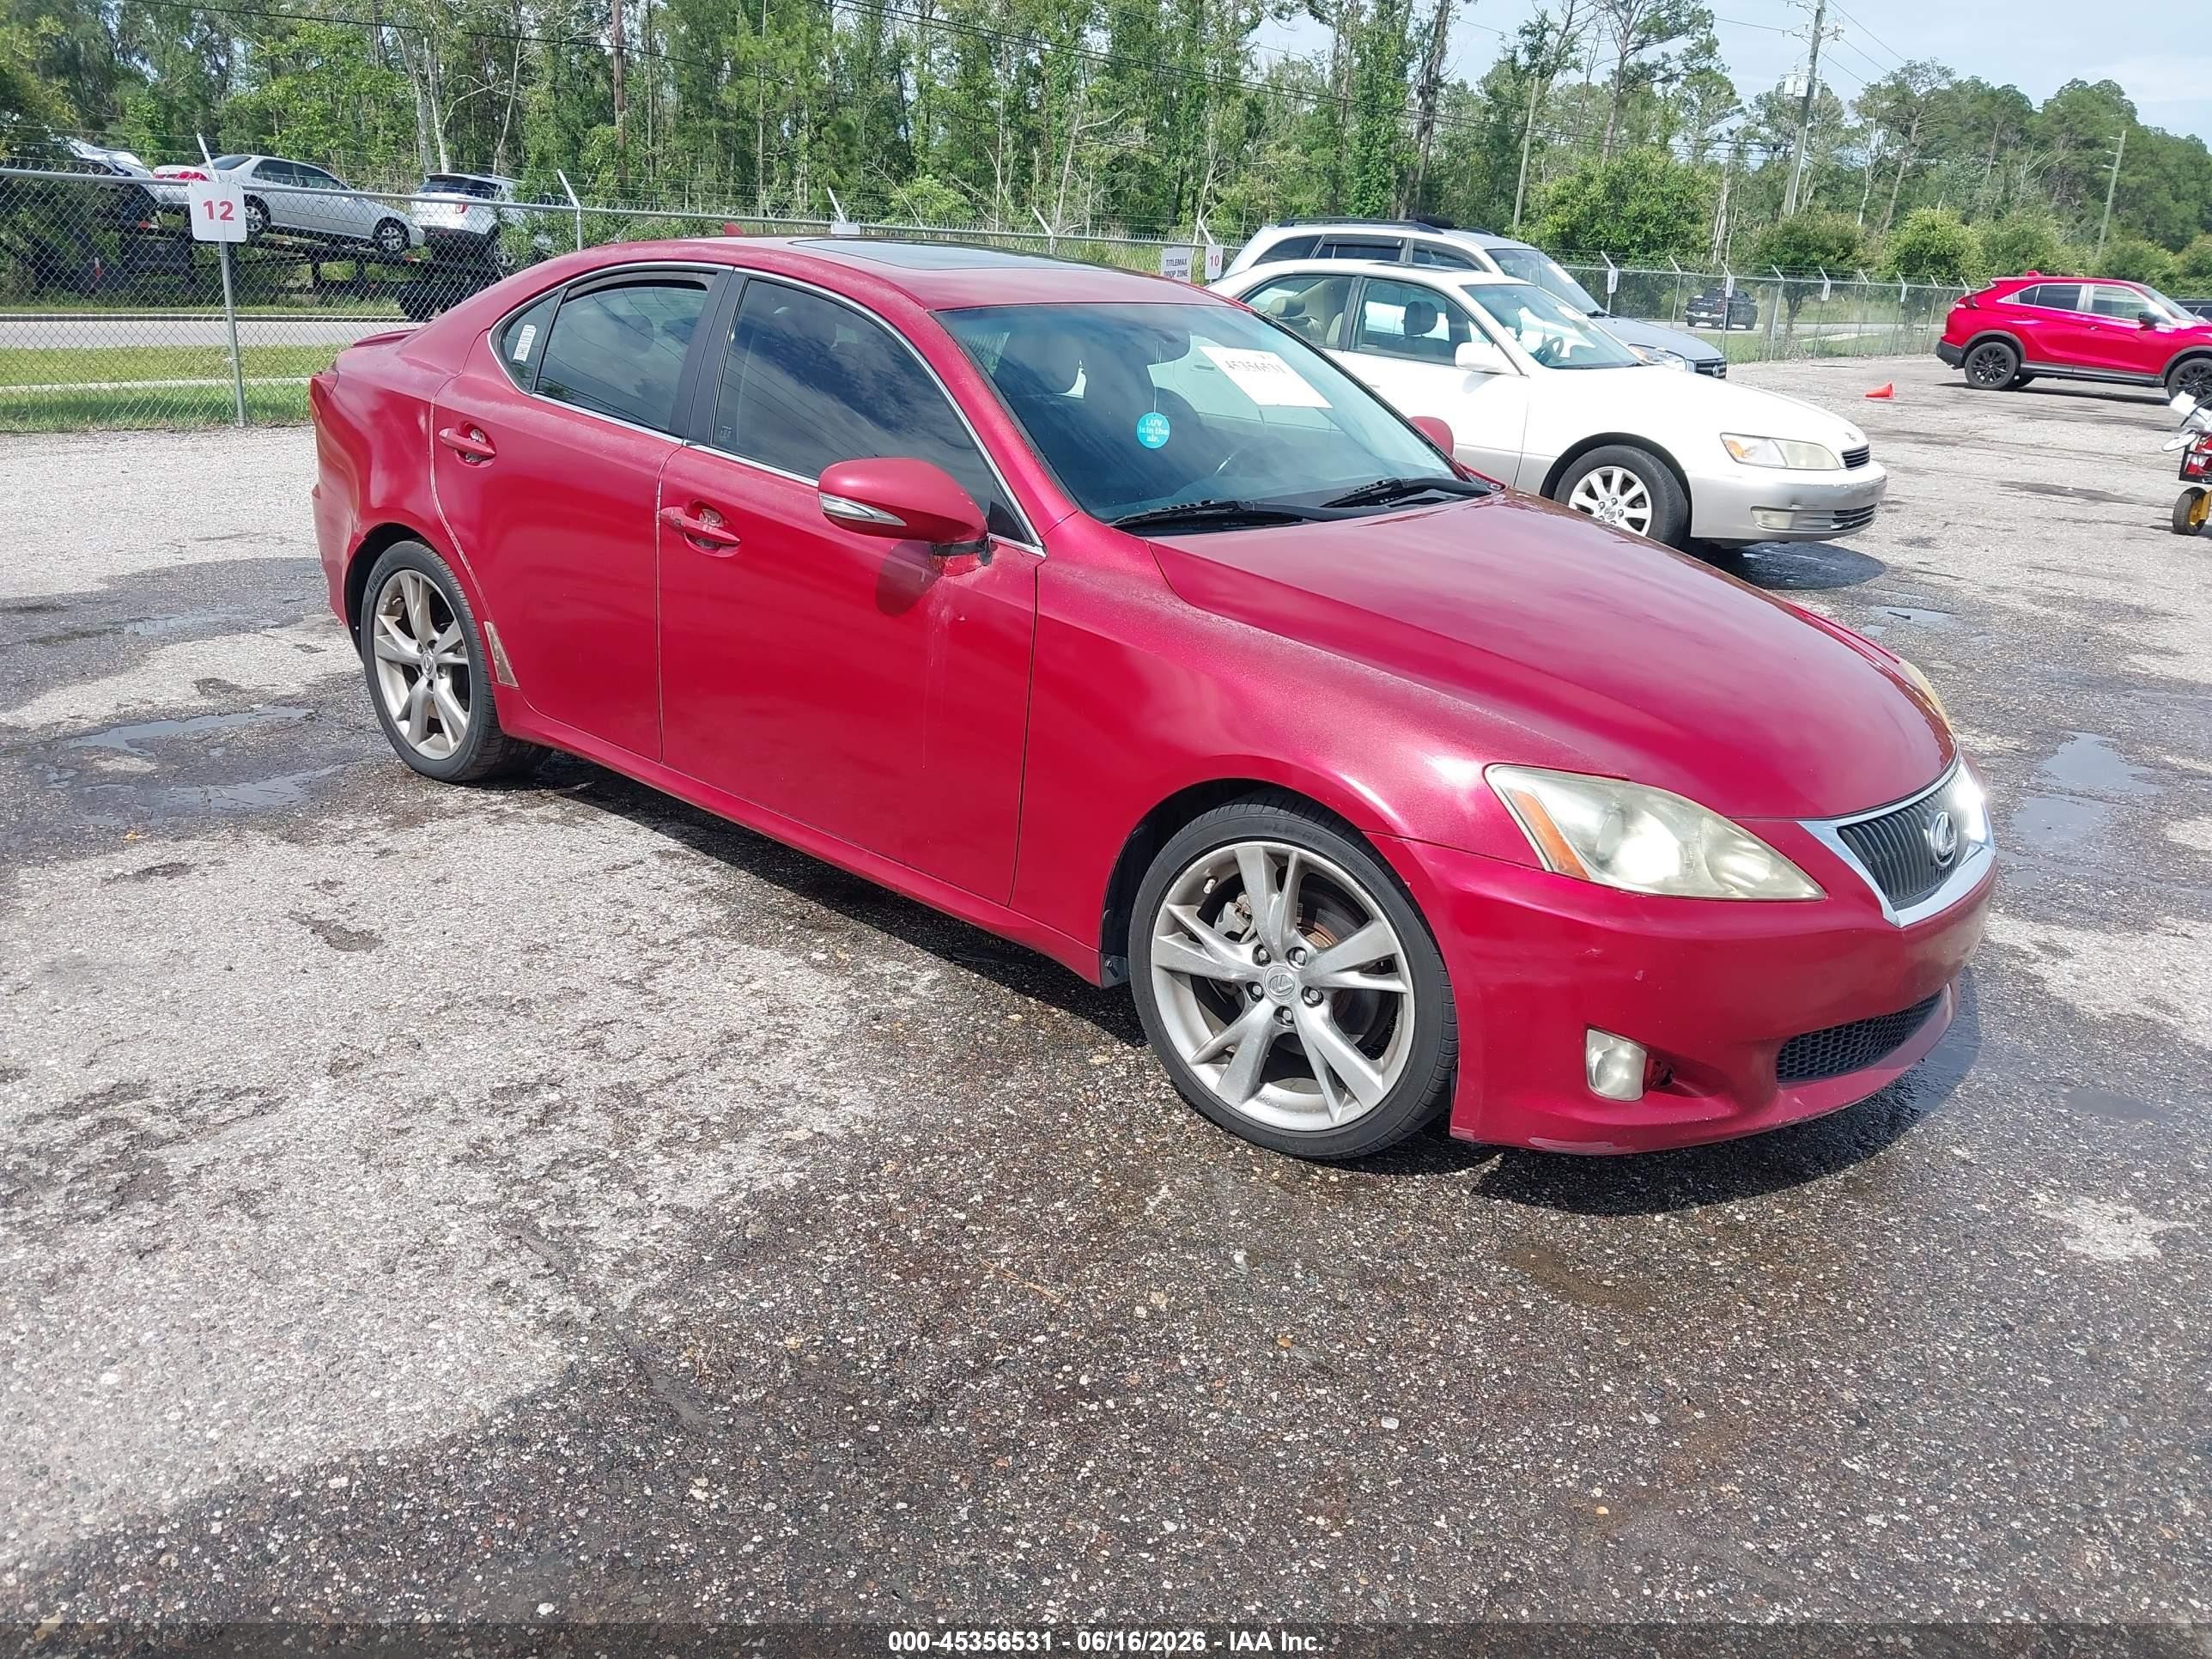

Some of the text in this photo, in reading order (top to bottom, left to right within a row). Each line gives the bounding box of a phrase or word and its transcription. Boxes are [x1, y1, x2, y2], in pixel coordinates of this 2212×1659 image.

[203, 200, 234, 221] 12
[1210, 255, 1219, 268] 10
[1176, 269, 1188, 277] ZONE
[1146, 418, 1163, 427] LUV
